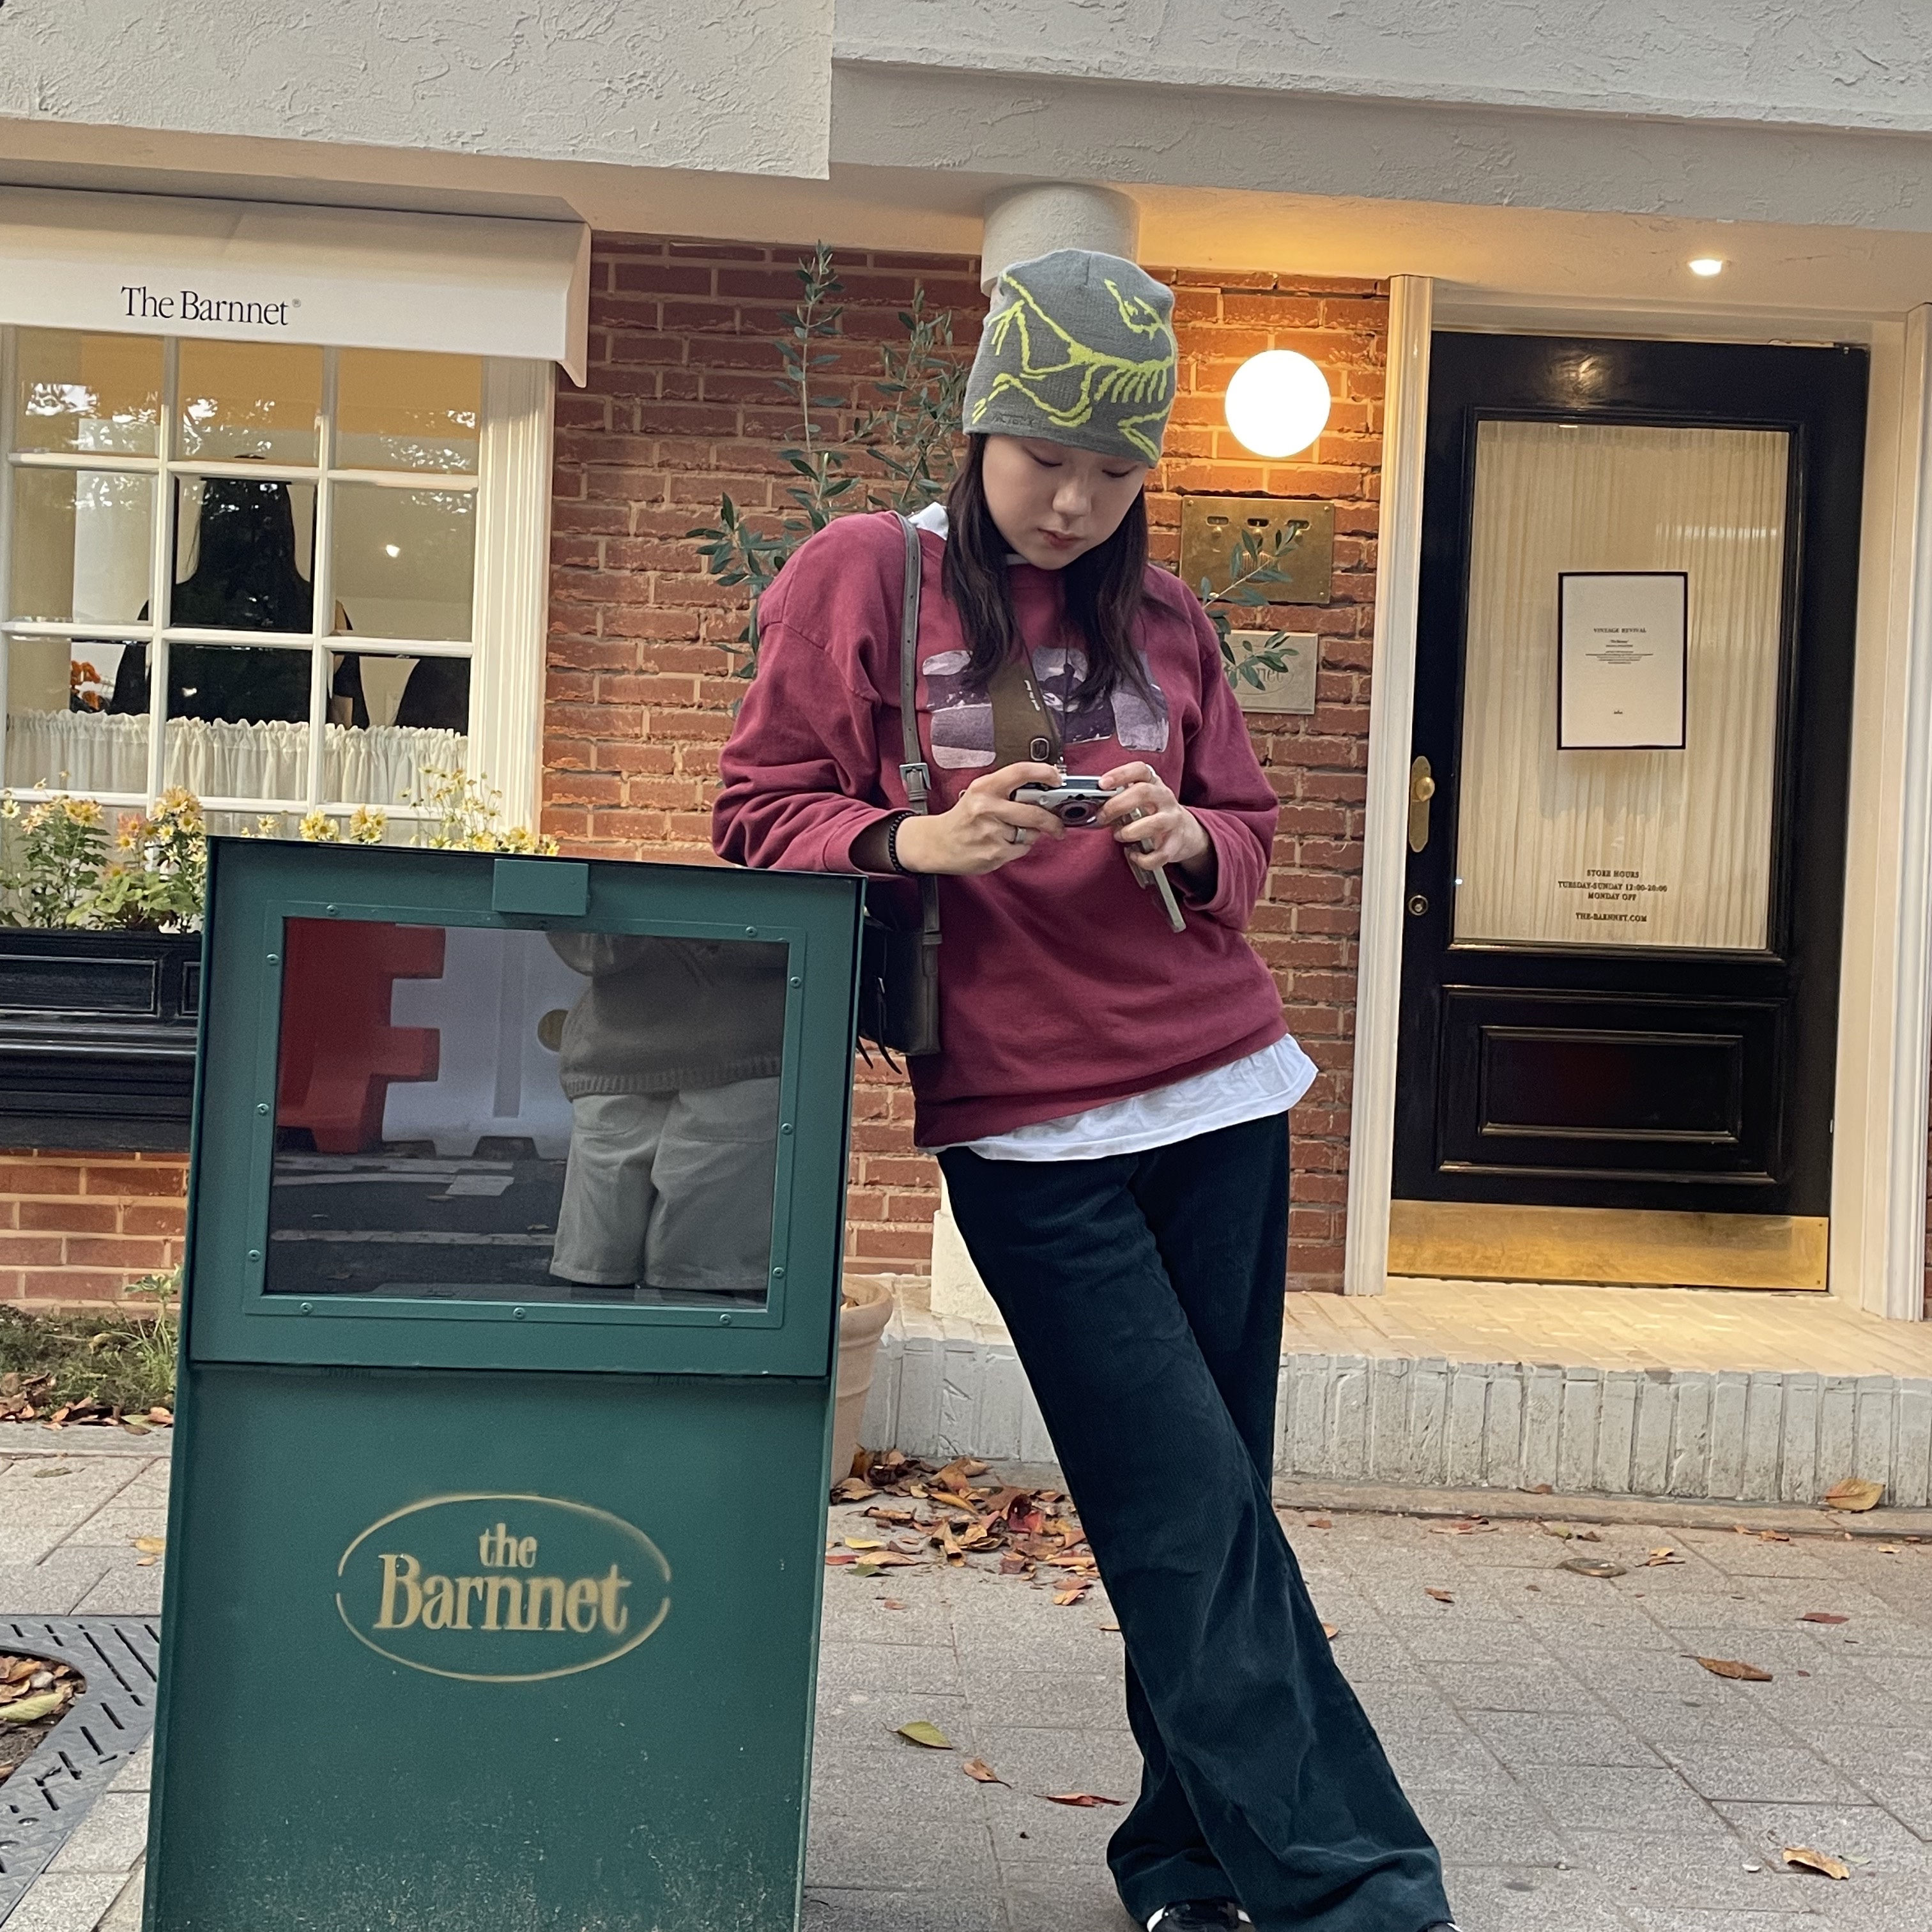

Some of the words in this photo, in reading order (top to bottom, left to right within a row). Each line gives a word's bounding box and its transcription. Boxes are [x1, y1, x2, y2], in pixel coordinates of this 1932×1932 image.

[120, 286, 174, 319] The
[180, 290, 289, 326] Barnnet
[1558, 881, 1623, 891] TUESDAY-SUNDAY
[1586, 869, 1611, 877] STORE
[1613, 870, 1639, 878] HOURS
[1588, 892, 1620, 900] MONDAY
[479, 1522, 538, 1568] the
[372, 1553, 632, 1636] Barnnet
